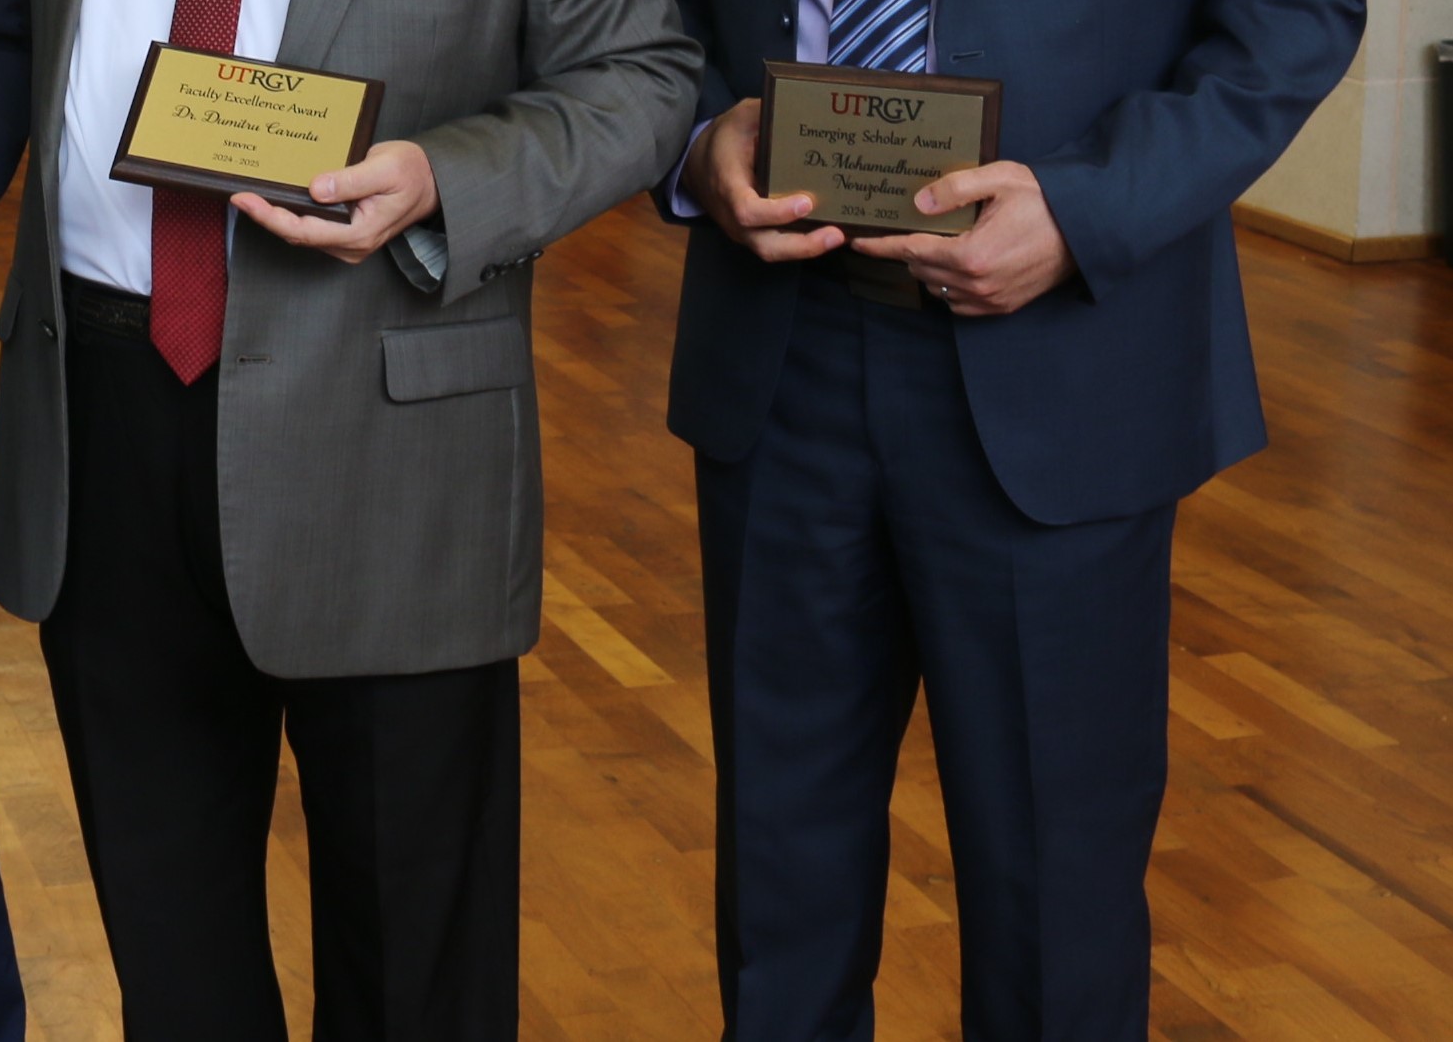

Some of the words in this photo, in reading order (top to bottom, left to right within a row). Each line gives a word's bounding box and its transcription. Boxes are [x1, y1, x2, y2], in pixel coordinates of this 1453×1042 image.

[217, 63, 305, 93] UTRGV
[179, 83, 222, 102] Faculty
[224, 92, 285, 112] Excellence
[286, 103, 329, 119] Award
[830, 92, 925, 124] UTRGV
[172, 105, 196, 121] Dr.
[202, 110, 261, 132] Dumitru
[265, 121, 320, 143] Caruntu
[799, 123, 856, 145] Emerging
[862, 130, 907, 146] Scholar
[912, 136, 952, 151] Award
[213, 153, 233, 164] 2024
[223, 139, 258, 152] SERVICE
[804, 150, 829, 167] Dr.
[832, 152, 942, 179] Mohamadhossein
[841, 205, 866, 217] 2024
